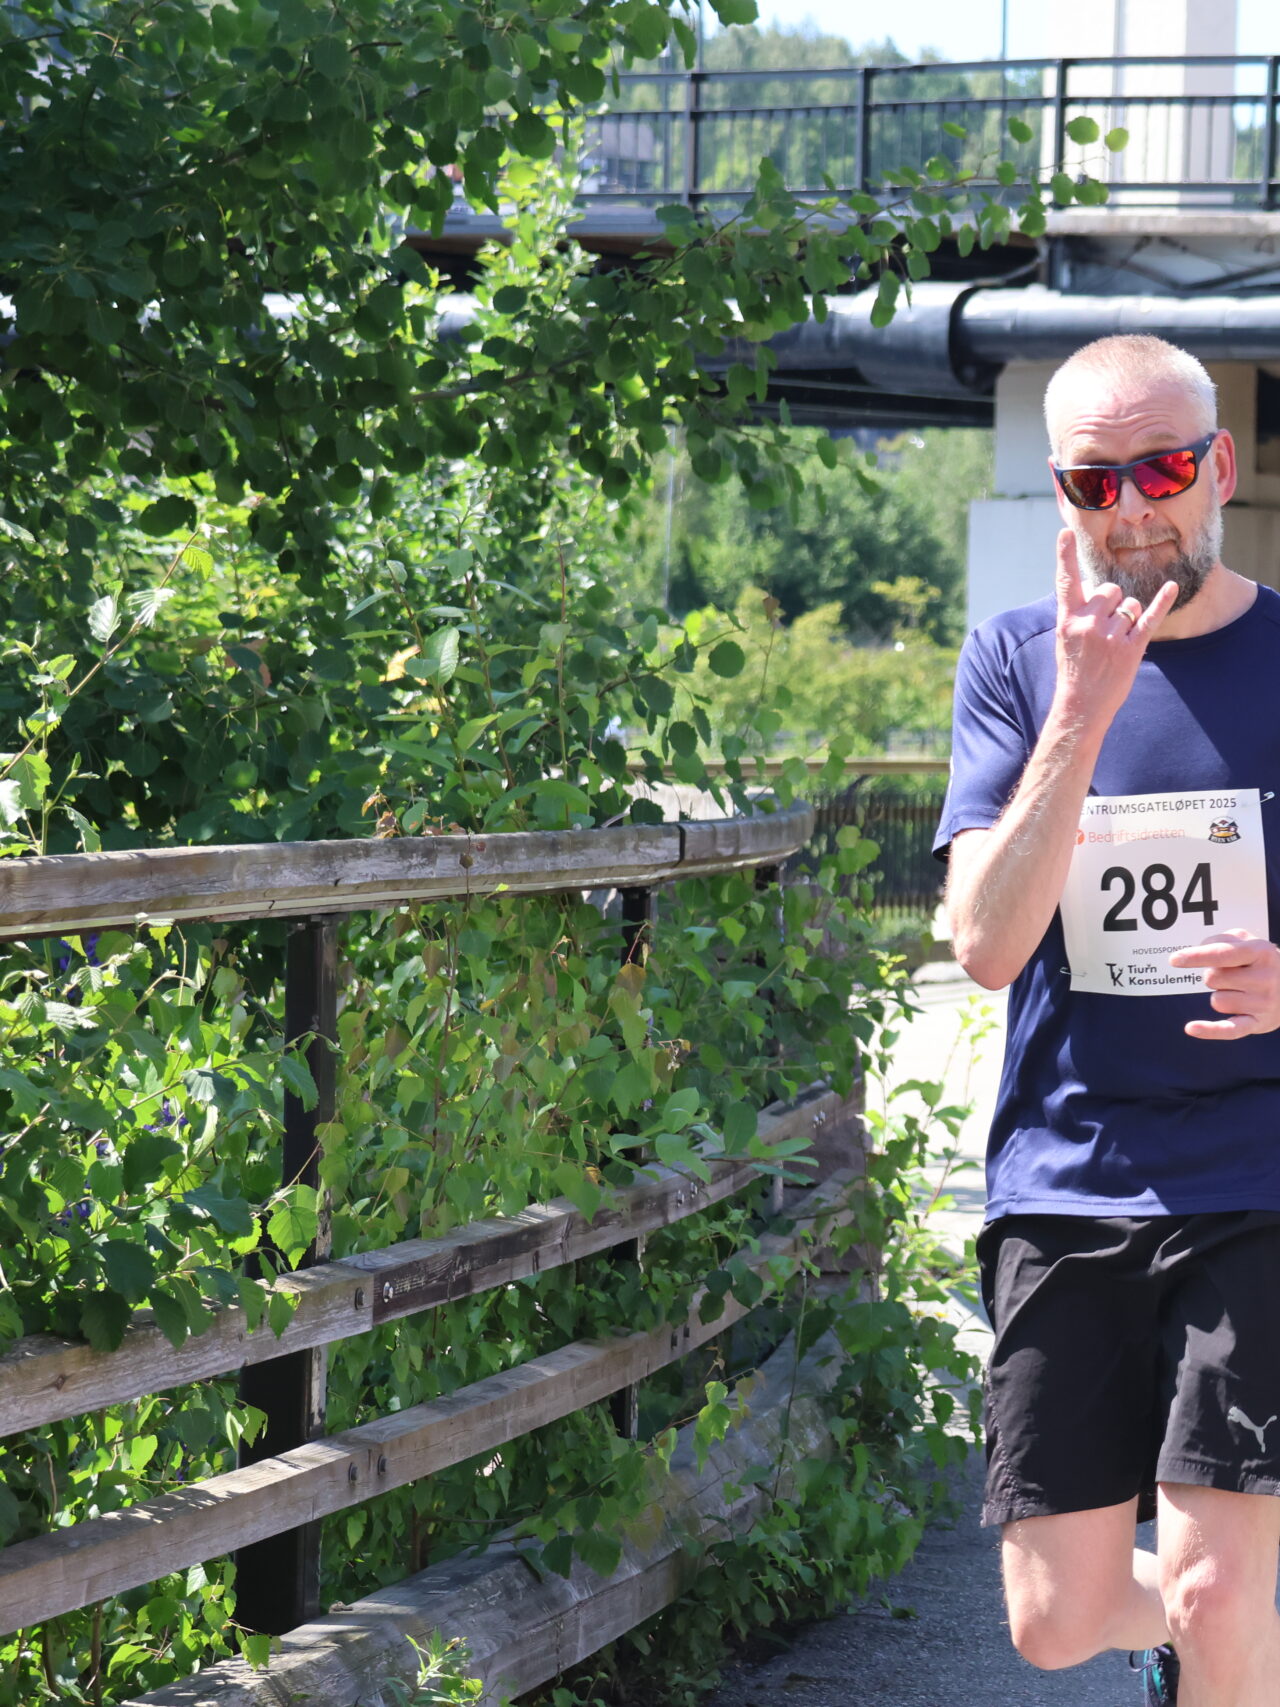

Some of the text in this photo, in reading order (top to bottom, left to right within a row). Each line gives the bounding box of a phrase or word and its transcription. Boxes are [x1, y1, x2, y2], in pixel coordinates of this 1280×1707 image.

[1209, 797, 1238, 809] 2025
[1088, 827, 1185, 843] Bedriftsidretten
[1100, 862, 1219, 932] 284
